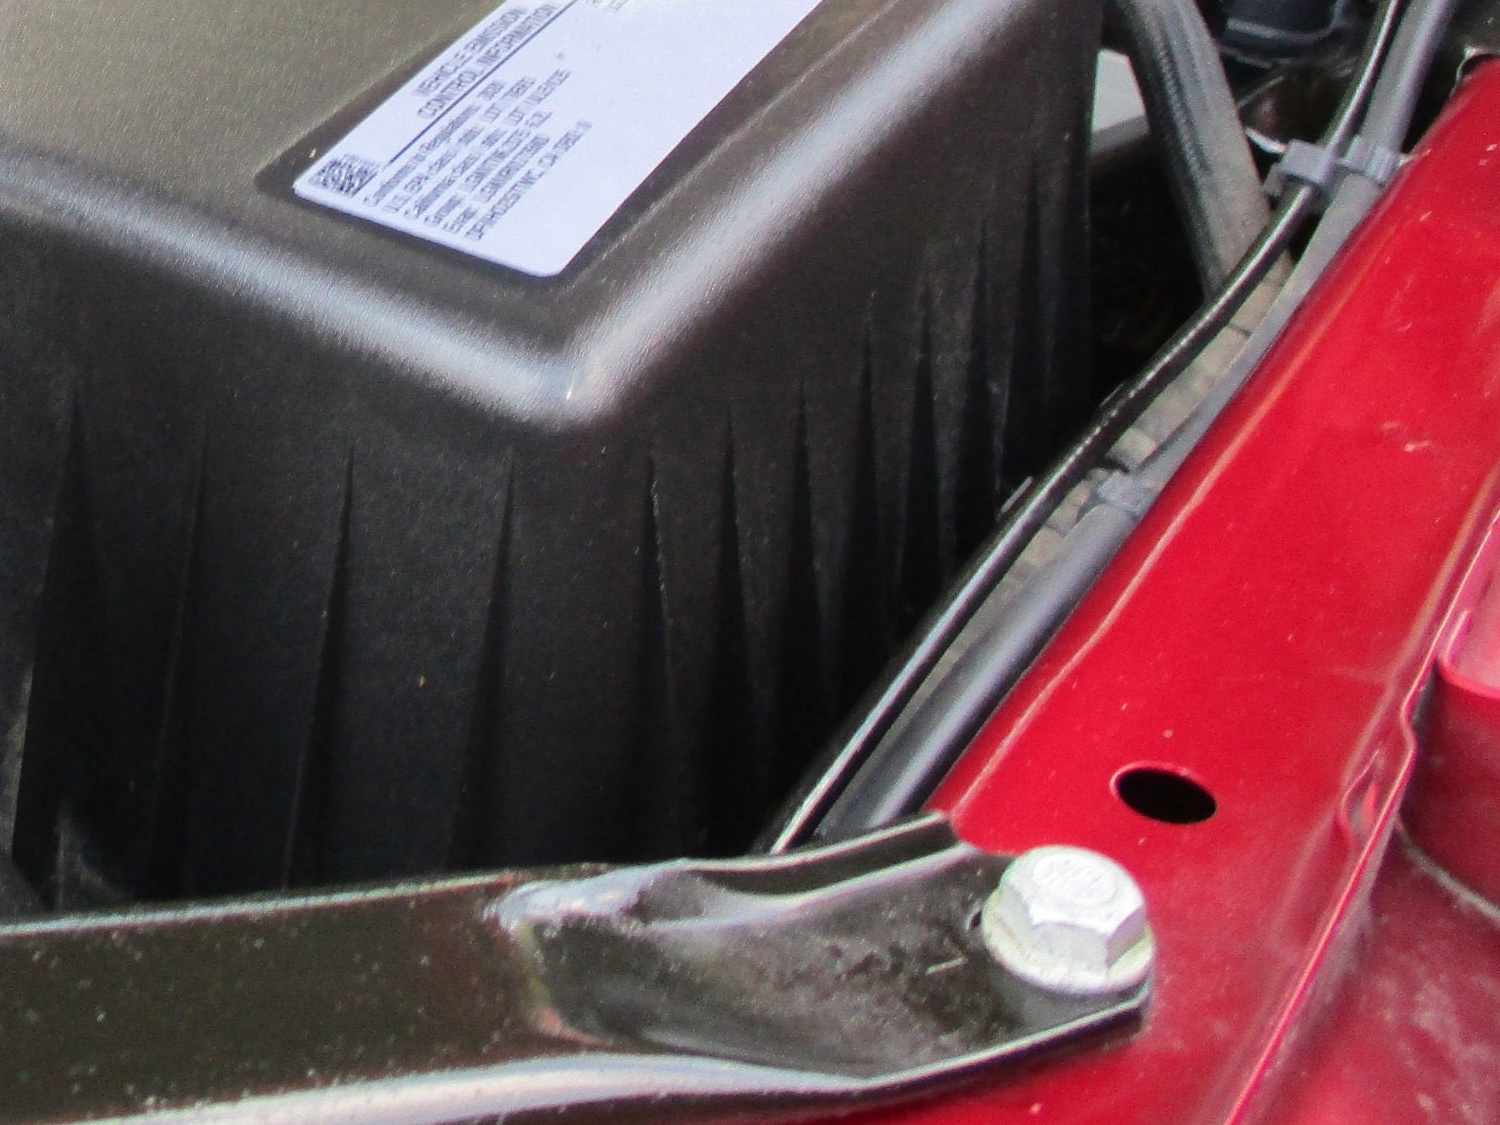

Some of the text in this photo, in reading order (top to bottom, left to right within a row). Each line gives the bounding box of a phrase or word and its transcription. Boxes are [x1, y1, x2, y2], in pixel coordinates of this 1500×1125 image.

[411, 6, 528, 97] VEHICLE EMISSION
[414, 2, 561, 118] CONTROL INFORMATION
